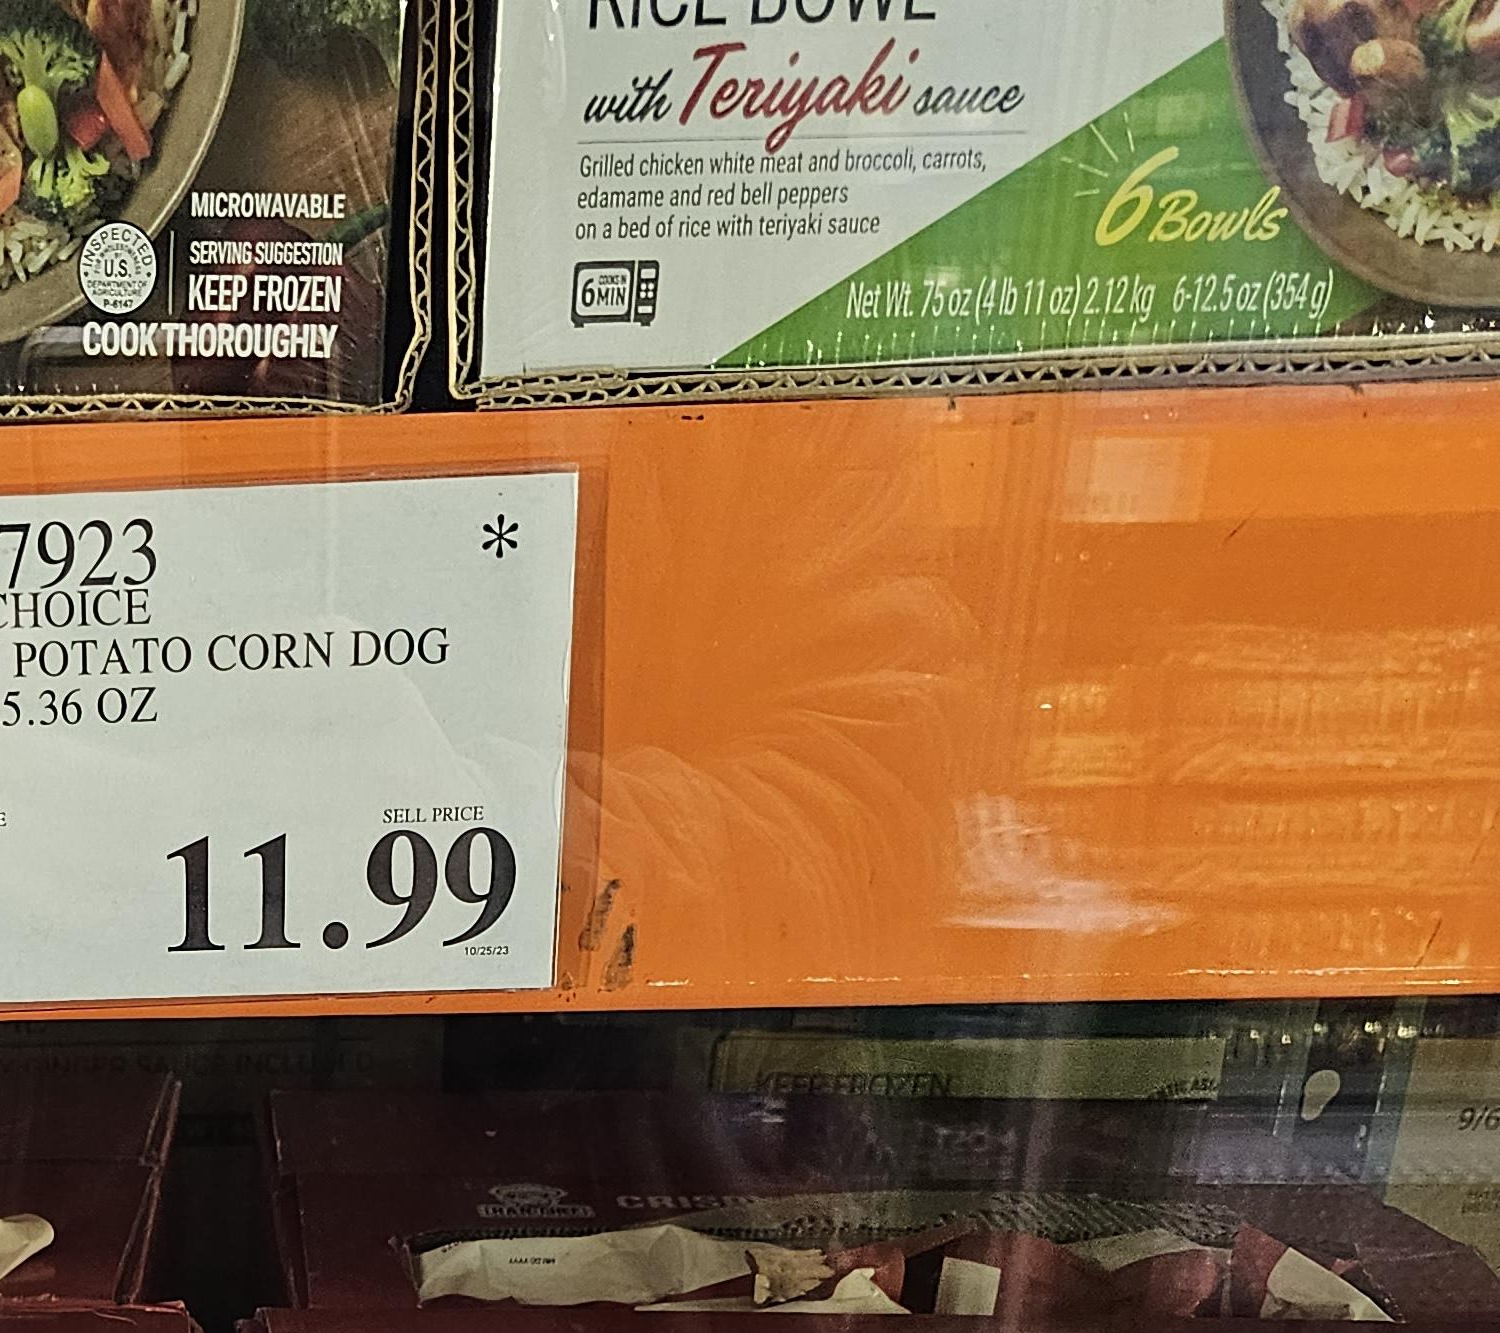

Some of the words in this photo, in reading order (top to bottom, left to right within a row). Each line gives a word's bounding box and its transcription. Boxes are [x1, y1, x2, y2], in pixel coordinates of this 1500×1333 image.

[582, 68, 674, 126] with
[678, 36, 921, 156] Teriyaki
[913, 83, 1026, 118] sauce
[580, 153, 635, 178] Grilled
[639, 151, 704, 177] chicken
[708, 151, 756, 176] white
[759, 153, 804, 175] meat
[808, 149, 840, 173] and
[844, 148, 917, 176] broccoli,
[921, 147, 988, 174] carrots,
[190, 192, 347, 219] MICROWAVABLE
[576, 185, 666, 209] edamame
[669, 184, 702, 208] and
[706, 183, 736, 207] red
[740, 182, 773, 206] bell
[776, 184, 849, 211] peppers
[1094, 145, 1180, 247] 6
[1147, 184, 1289, 243] Bowls
[574, 222, 598, 240] on
[602, 222, 613, 239] a
[617, 216, 652, 240] bed
[655, 215, 675, 239] of
[678, 215, 711, 239] rice
[716, 213, 754, 238] with
[758, 213, 823, 241] teriyaki
[826, 218, 882, 236] sauce
[189, 240, 252, 266] SERVING
[254, 241, 343, 266] SUGGESTION
[188, 274, 248, 312] KEEP
[252, 275, 342, 313] FROZEN
[82, 320, 159, 357] COOK
[160, 322, 340, 359] THOROUGHLY
[13, 636, 193, 679] POTATO
[207, 631, 336, 673] CORN
[350, 626, 452, 668] DOG
[97, 685, 159, 725] OZ
[381, 807, 428, 825] SELL
[430, 804, 486, 824] PRICE
[165, 826, 518, 953] 11.99
[463, 944, 511, 958] 10/25/23
